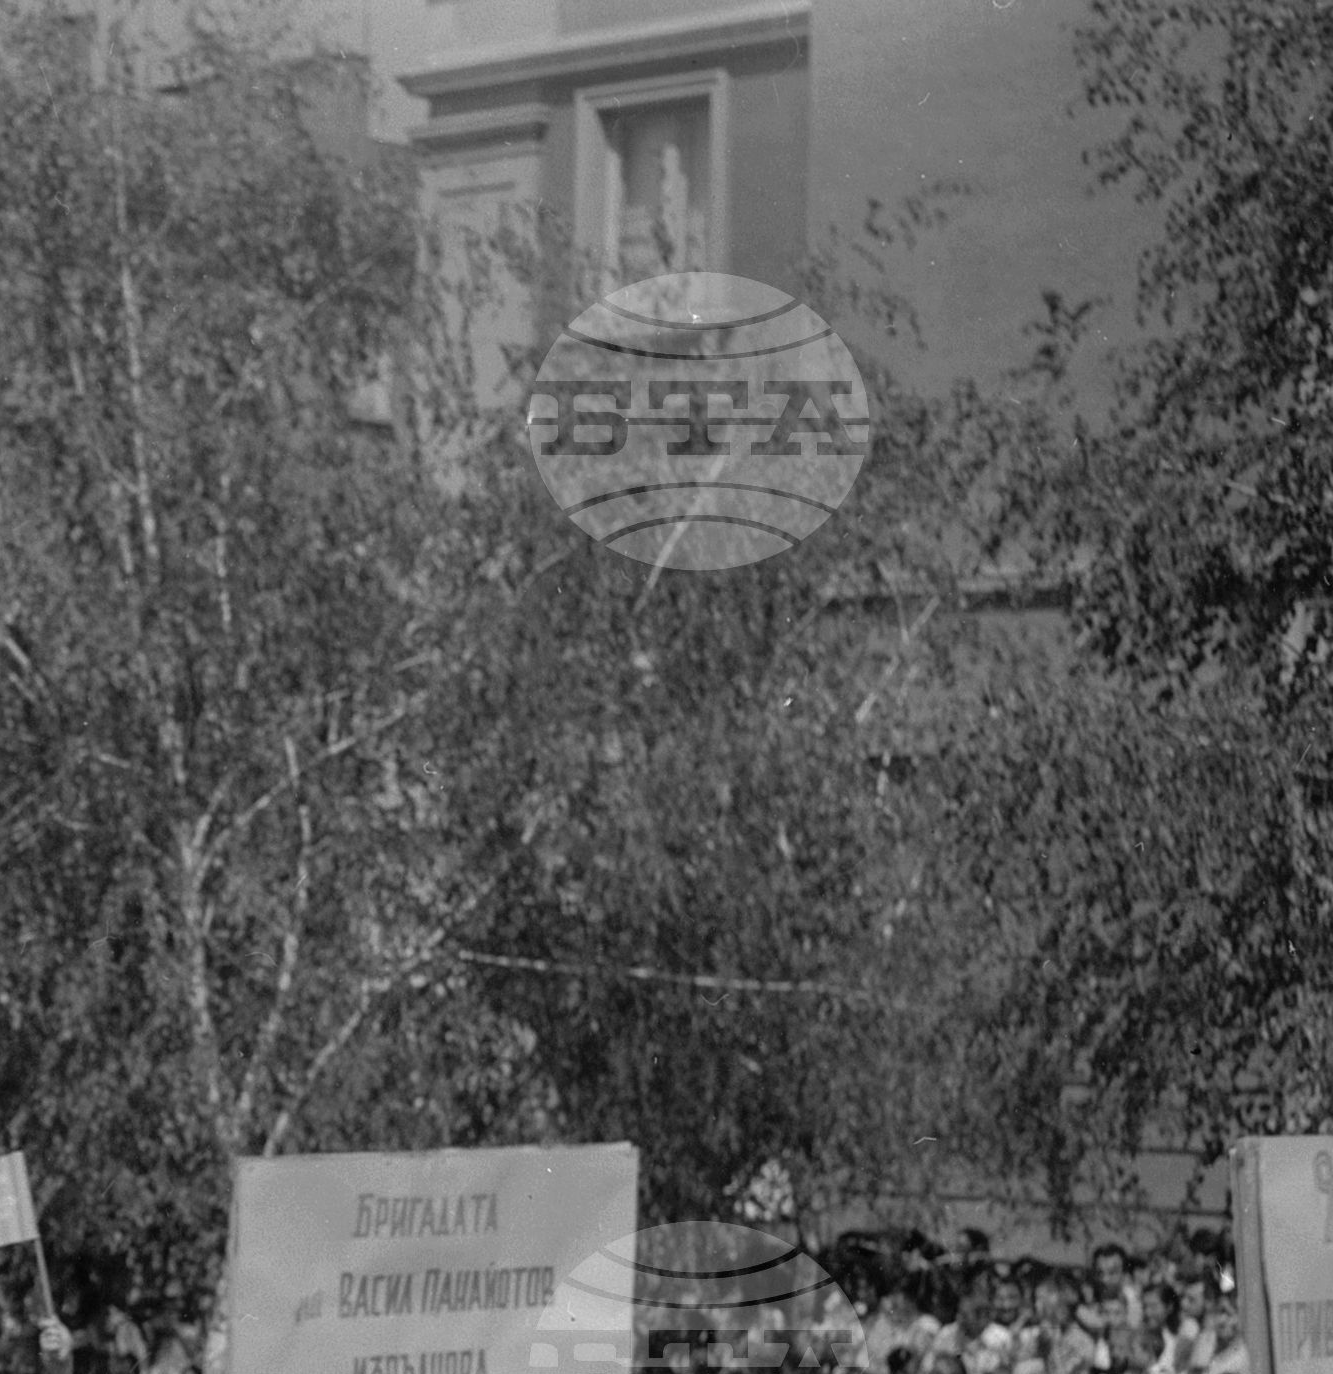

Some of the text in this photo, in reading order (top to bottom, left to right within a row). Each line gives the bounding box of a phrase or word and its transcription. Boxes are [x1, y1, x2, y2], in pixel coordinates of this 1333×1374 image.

[353, 1192, 499, 1239] БРИГАДАТА
[337, 1270, 415, 1319] ВАСИЛ
[418, 1261, 555, 1316] ПАНАЙОТОВ
